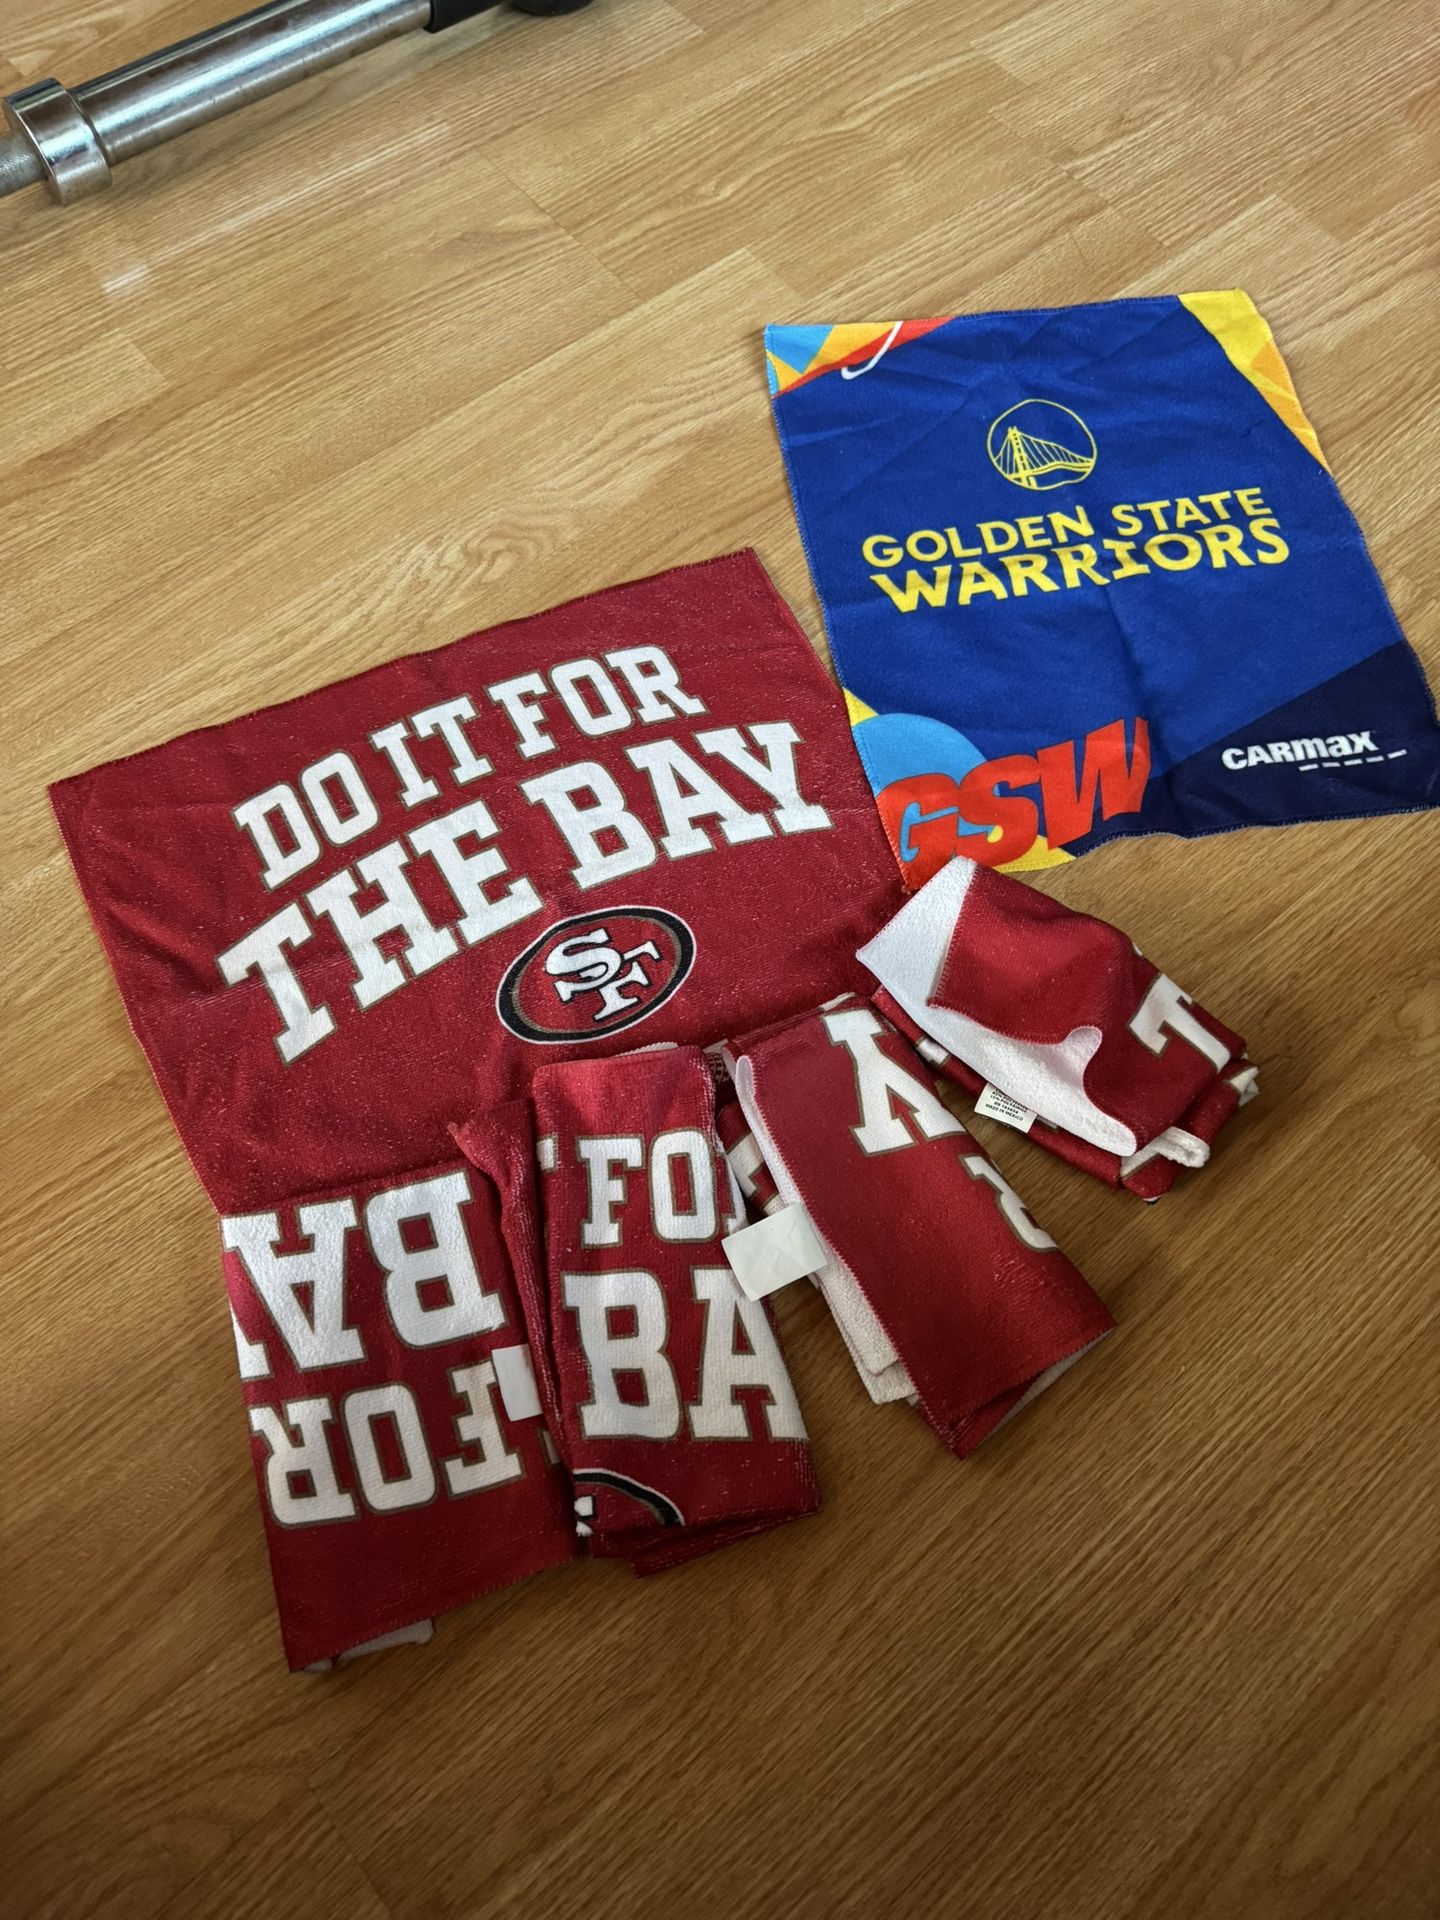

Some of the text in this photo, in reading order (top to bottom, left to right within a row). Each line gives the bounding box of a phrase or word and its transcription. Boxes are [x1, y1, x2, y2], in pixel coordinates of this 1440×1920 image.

[862, 487, 1272, 568] GOLDEN STATE
[870, 517, 1289, 613] WARRIORS
[232, 645, 704, 890] DO IT FOR
[876, 717, 1151, 889] GSW
[214, 721, 833, 1066] THE BAY
[545, 927, 662, 1021] SF
[985, 1103, 999, 1112] MADE
[1005, 1110, 1024, 1121] MEXICO
[248, 1358, 525, 1527] FOR
